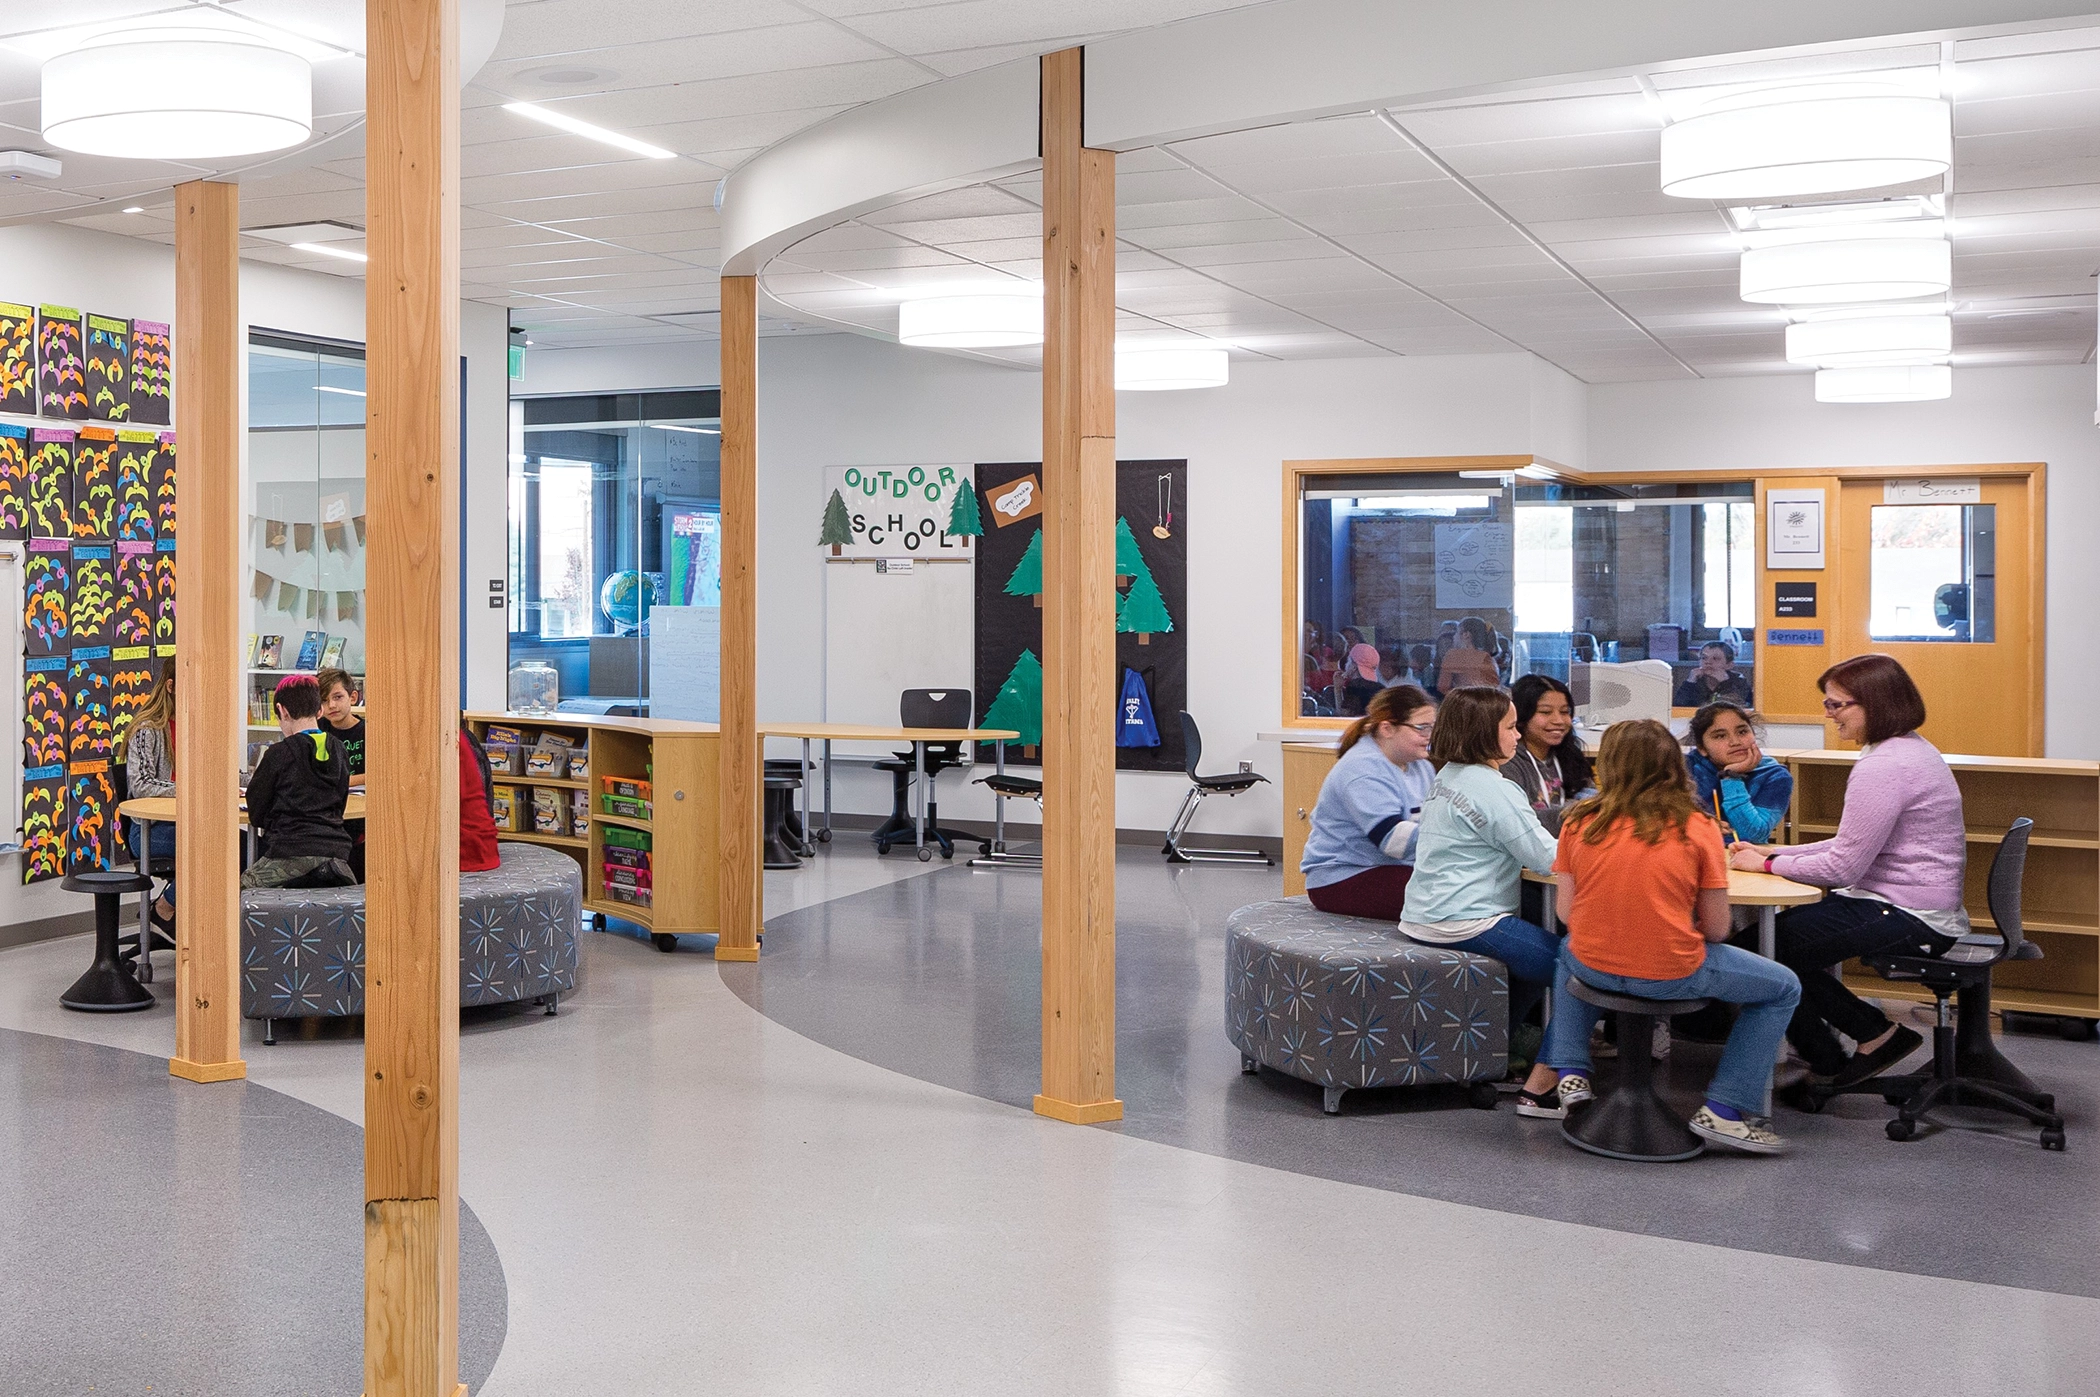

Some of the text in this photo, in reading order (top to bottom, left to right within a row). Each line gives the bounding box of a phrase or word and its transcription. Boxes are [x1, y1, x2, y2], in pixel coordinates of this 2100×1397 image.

[844, 466, 956, 502] OUTDOOR
[1918, 480, 1976, 497] Bennett
[852, 514, 953, 550] SCHOOL
[1771, 631, 1818, 641] Bennett
[1453, 792, 1488, 829] World
